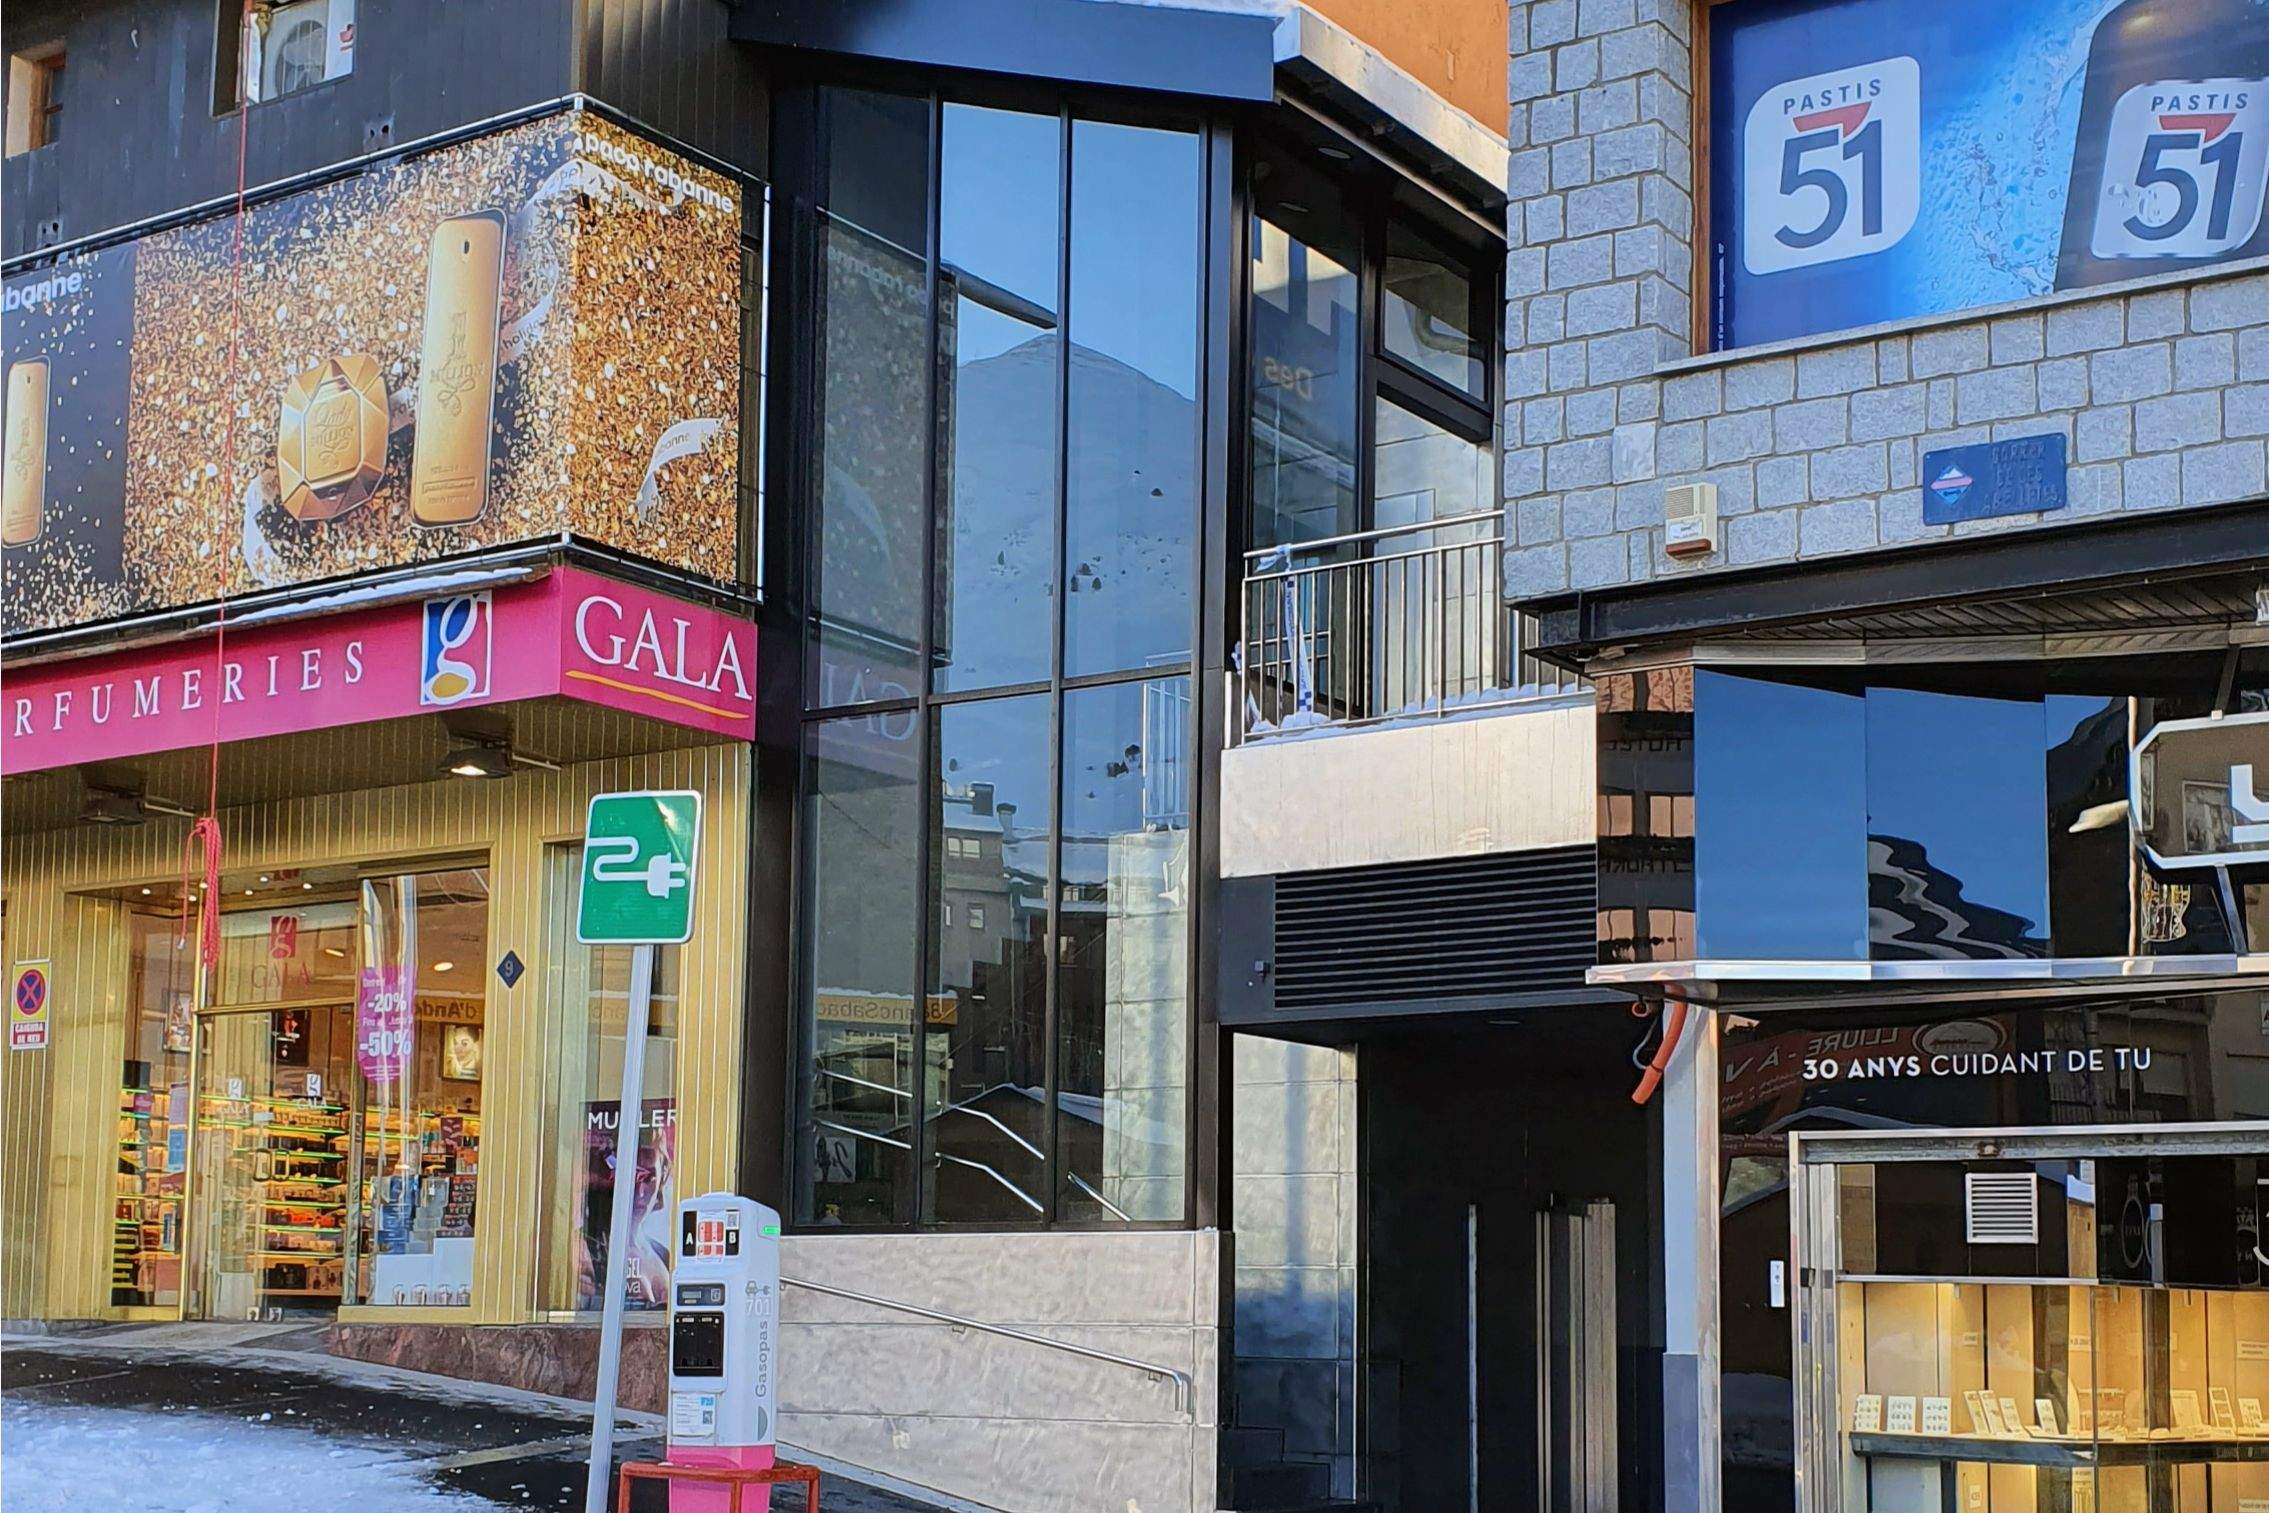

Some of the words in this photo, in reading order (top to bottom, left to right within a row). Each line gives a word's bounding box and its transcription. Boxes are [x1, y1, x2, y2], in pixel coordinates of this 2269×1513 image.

[1783, 78, 1882, 115] PASTIS
[2151, 92, 2249, 112] PASTIS
[585, 134, 641, 173] paco
[644, 160, 734, 214] rabanne
[1774, 119, 1883, 249] 51
[2123, 131, 2244, 241] 51
[0, 271, 83, 314] banne
[575, 596, 752, 700] GALA
[14, 641, 364, 737] RFUMERIES
[505, 960, 514, 978] 9
[367, 992, 407, 1013] -20%
[359, 1029, 412, 1057] -50%
[1802, 1059, 1839, 1080] 30
[1848, 1055, 1921, 1079] ANYS
[1930, 1051, 2057, 1077] CUIDANT
[2068, 1050, 2104, 1072] DE
[2115, 1047, 2151, 1071] TU
[588, 1108, 679, 1131] MULER
[686, 1232, 694, 1245] A
[728, 1231, 737, 1244] B
[755, 1320, 770, 1398] Gasopas
